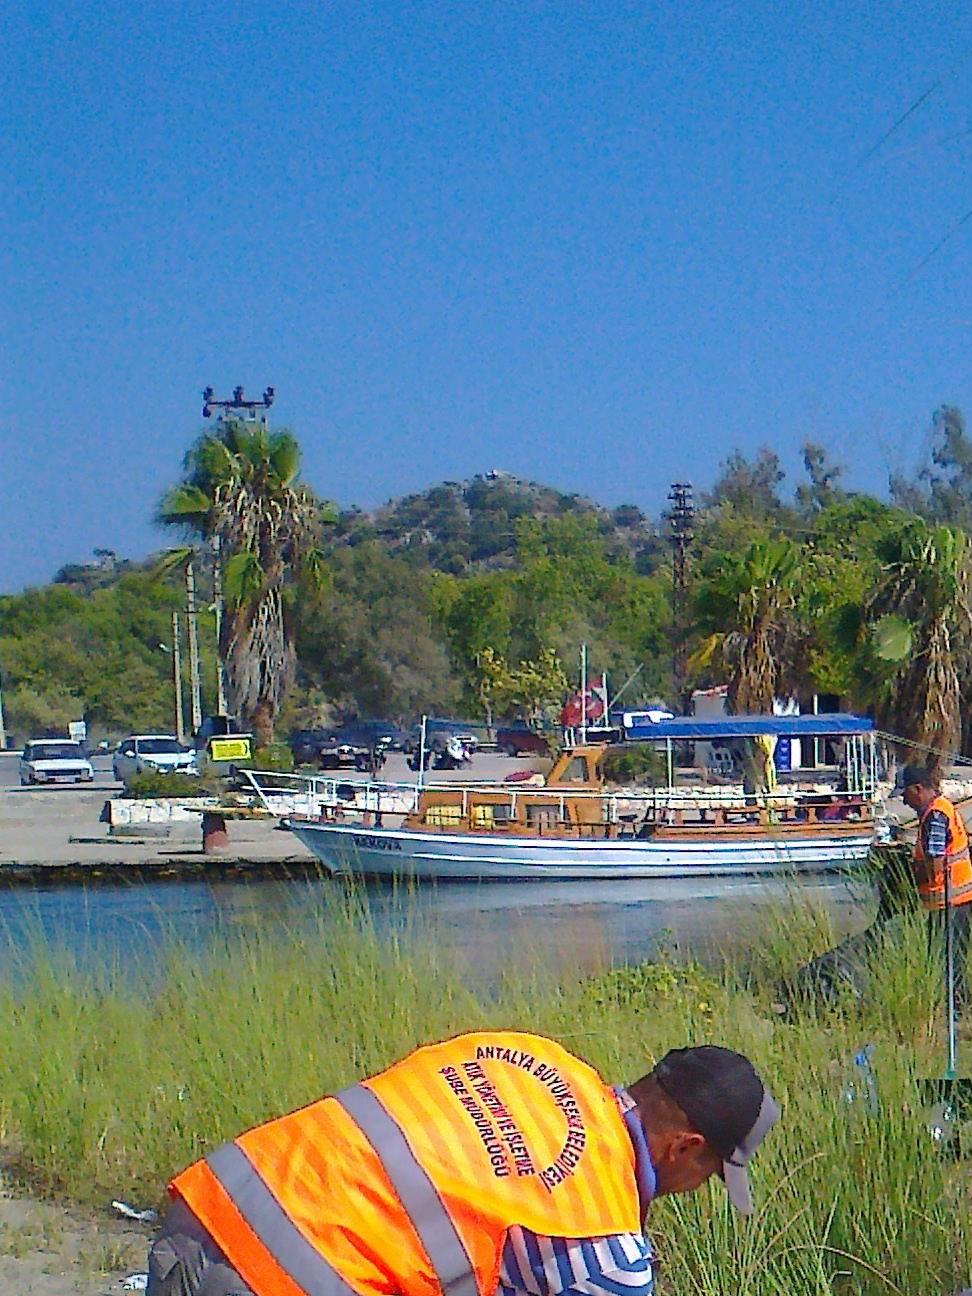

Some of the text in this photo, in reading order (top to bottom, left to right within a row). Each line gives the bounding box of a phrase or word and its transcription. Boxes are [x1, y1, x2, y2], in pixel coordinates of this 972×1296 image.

[477, 1046, 535, 1072] ANTALYA
[438, 1066, 512, 1178] ŞUBE MÜDÜRLÜĞÜ
